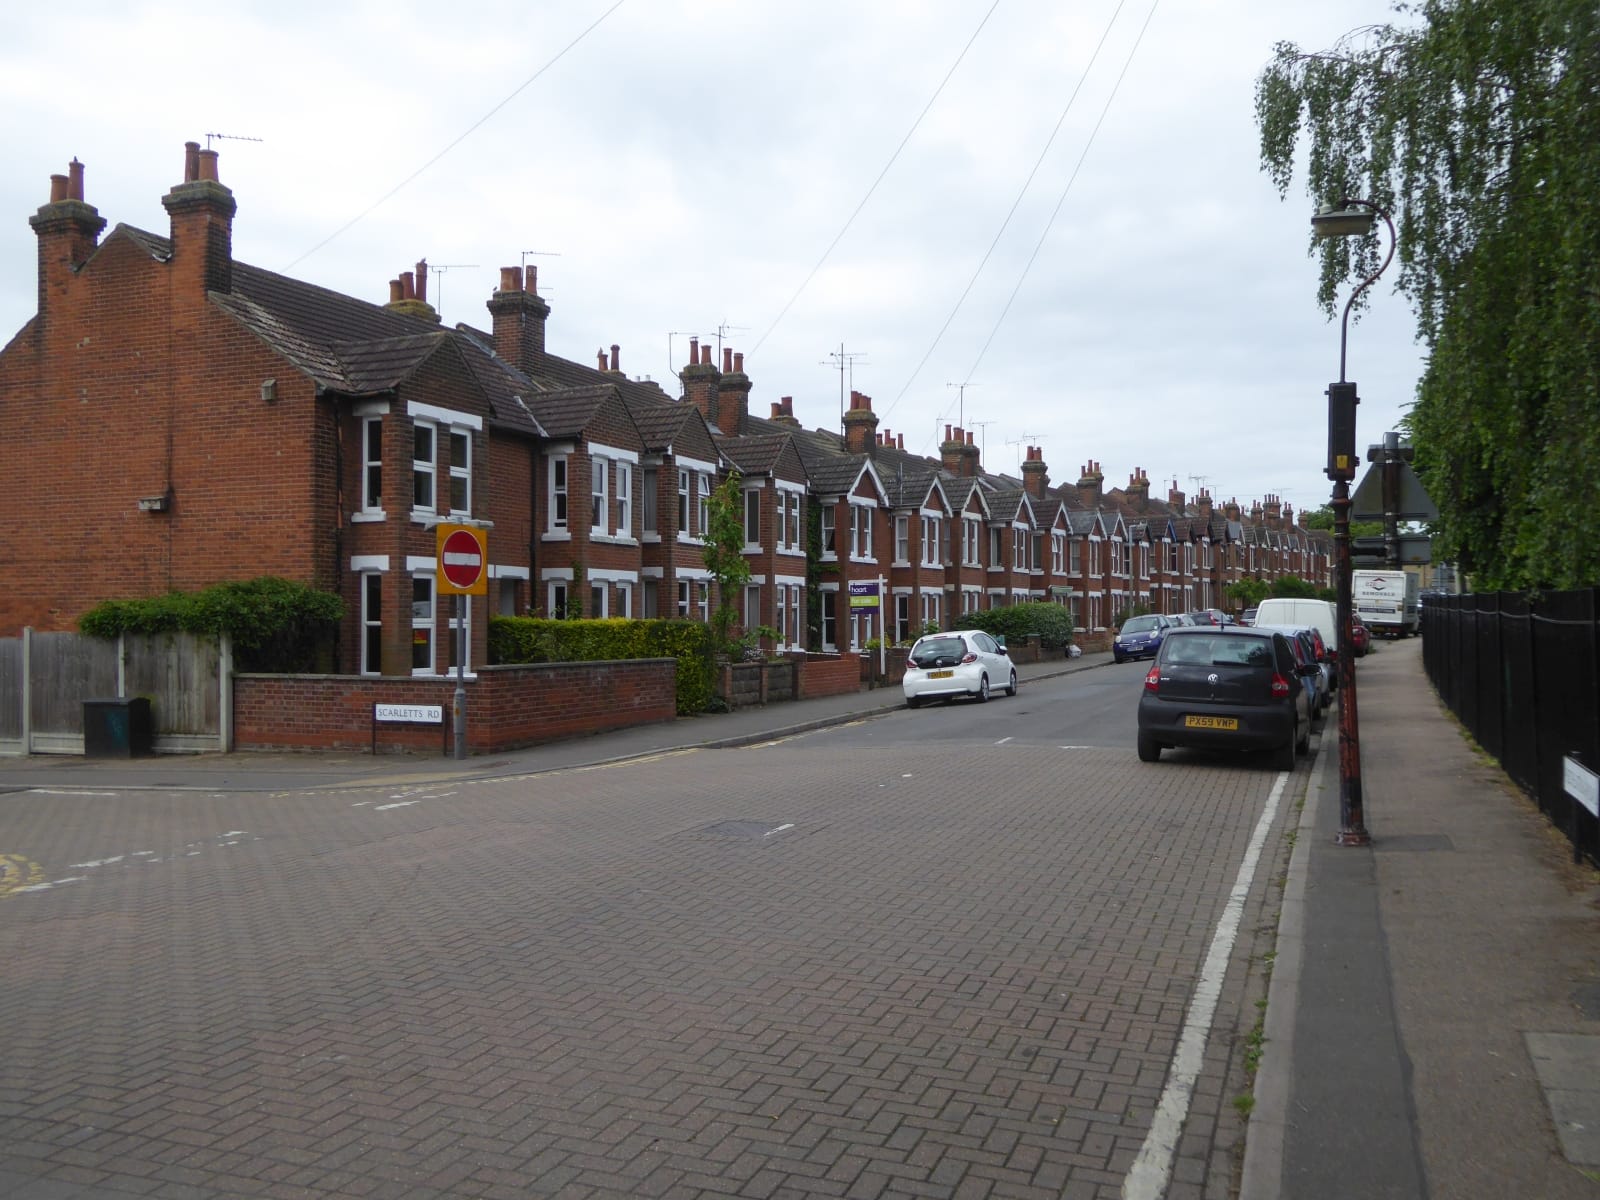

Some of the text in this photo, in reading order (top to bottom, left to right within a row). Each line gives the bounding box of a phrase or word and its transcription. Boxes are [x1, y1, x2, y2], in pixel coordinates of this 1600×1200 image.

[378, 708, 440, 719] SCARLETTS RD
[1189, 717, 1214, 727] PX59
